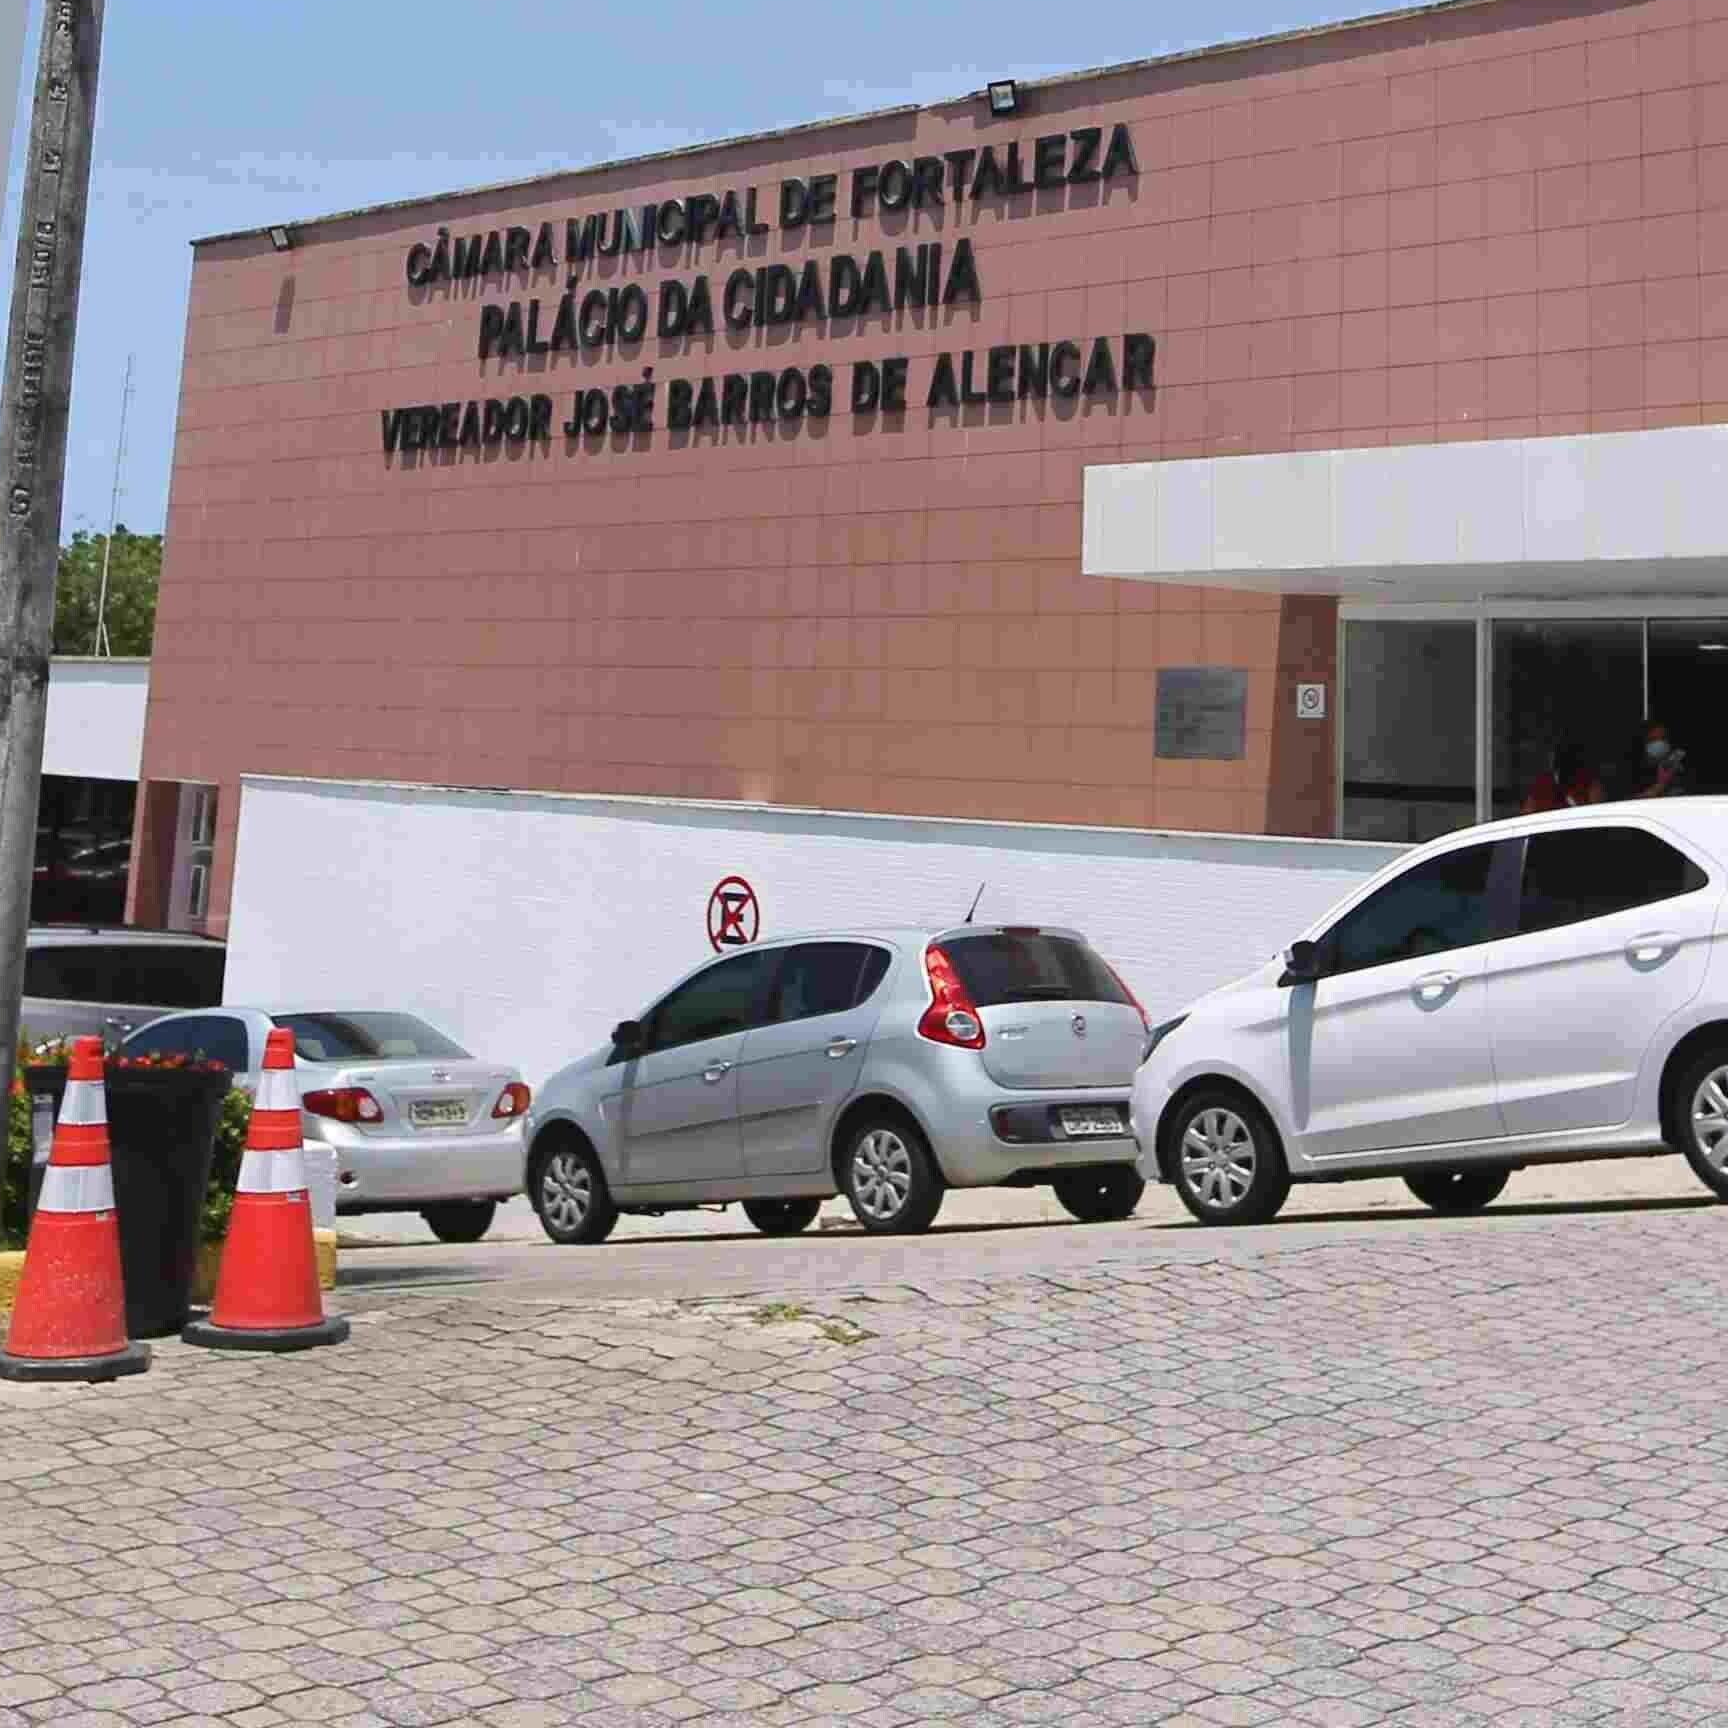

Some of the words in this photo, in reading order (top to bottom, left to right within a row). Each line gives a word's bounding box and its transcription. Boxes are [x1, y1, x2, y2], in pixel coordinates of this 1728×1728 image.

[406, 222, 559, 287] CÂMARA
[565, 186, 769, 263] MUNICIPAL
[779, 174, 838, 225] DE
[850, 123, 1139, 219] FORTALEZA
[477, 275, 649, 360] PALÁCIO
[656, 274, 715, 340] DA
[723, 238, 981, 327] CIDADANIA
[382, 393, 553, 451] VEREADOR
[563, 366, 656, 437] JOSÉ
[667, 362, 833, 430] BARROS
[851, 357, 909, 415] DE
[927, 333, 1156, 408] ALENCAR
